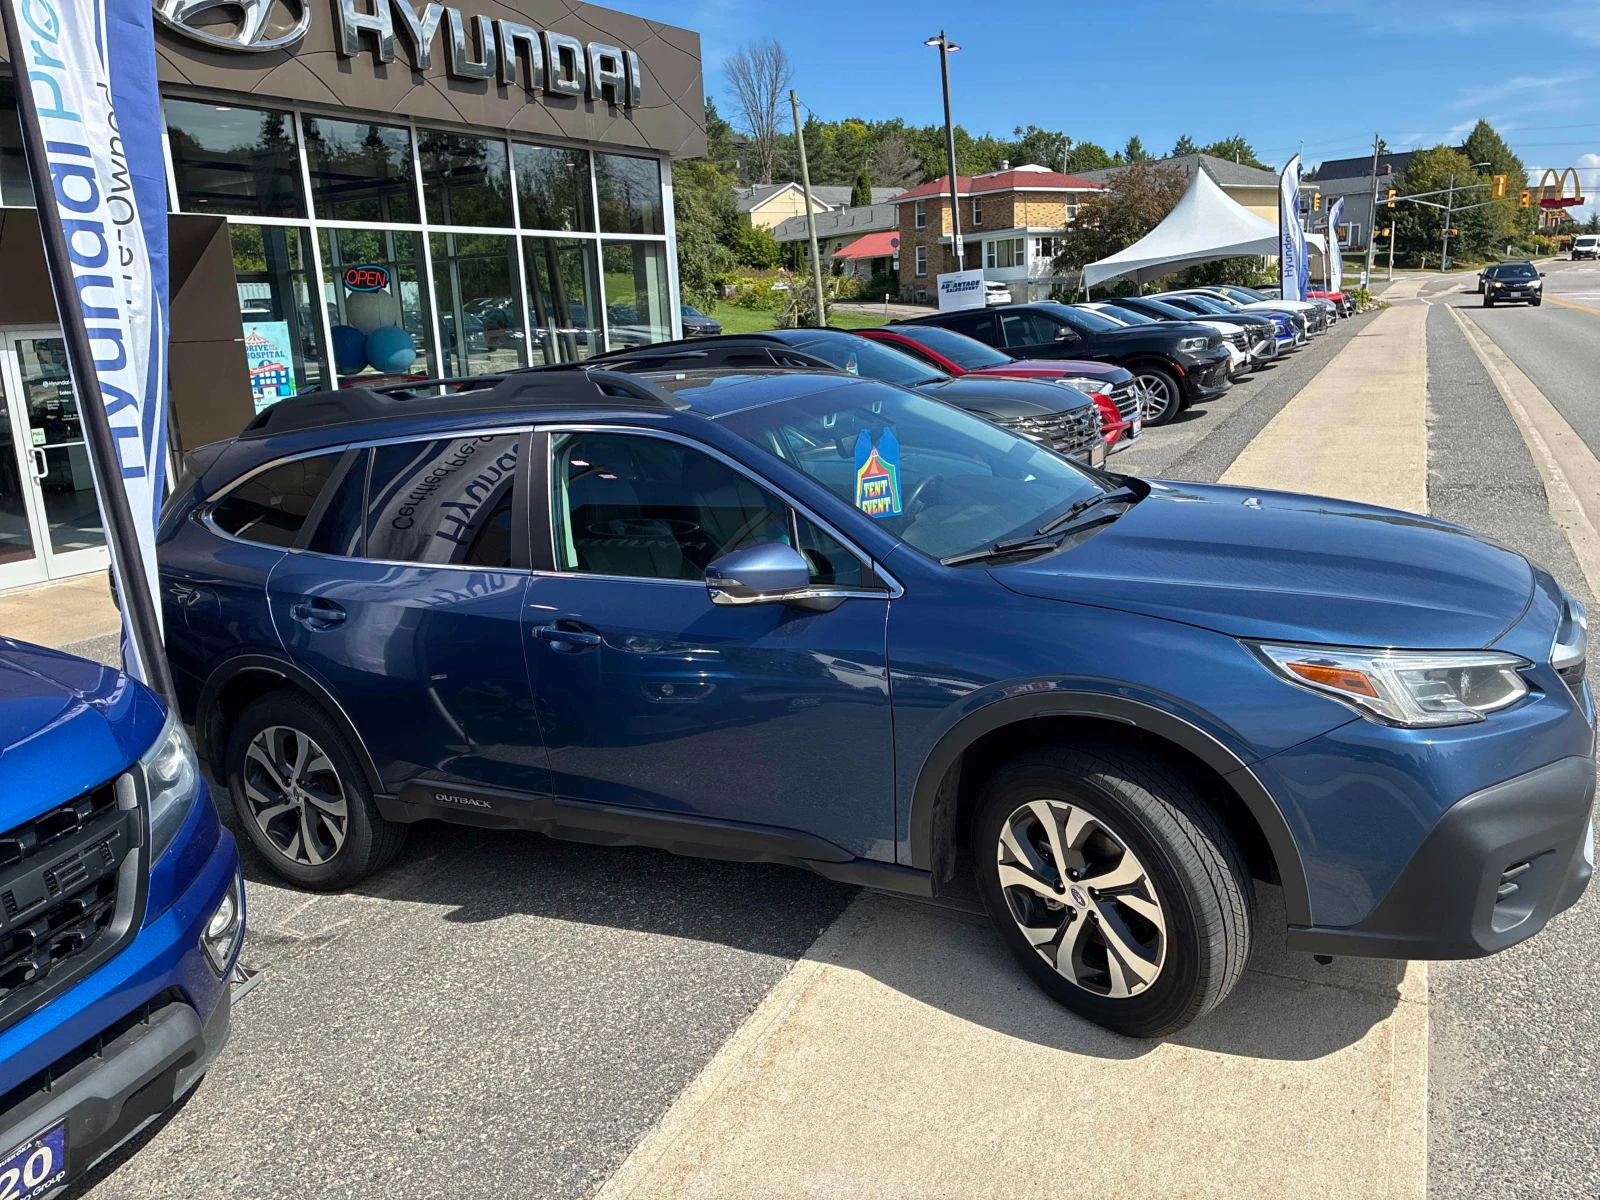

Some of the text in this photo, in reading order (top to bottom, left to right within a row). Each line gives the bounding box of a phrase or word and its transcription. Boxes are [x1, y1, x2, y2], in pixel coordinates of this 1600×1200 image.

[339, 0, 642, 108] HYUNDAI
[1283, 233, 1295, 278] Hyundai
[346, 269, 387, 287] OPEN
[46, 140, 147, 480] Hyundai
[245, 344, 269, 352] DRIVE
[863, 479, 888, 499] TENT
[862, 496, 891, 515] EVENT
[435, 793, 493, 809] OUTBACK
[0, 1142, 32, 1168] USKOKA
[32, 1170, 66, 1197] Group
